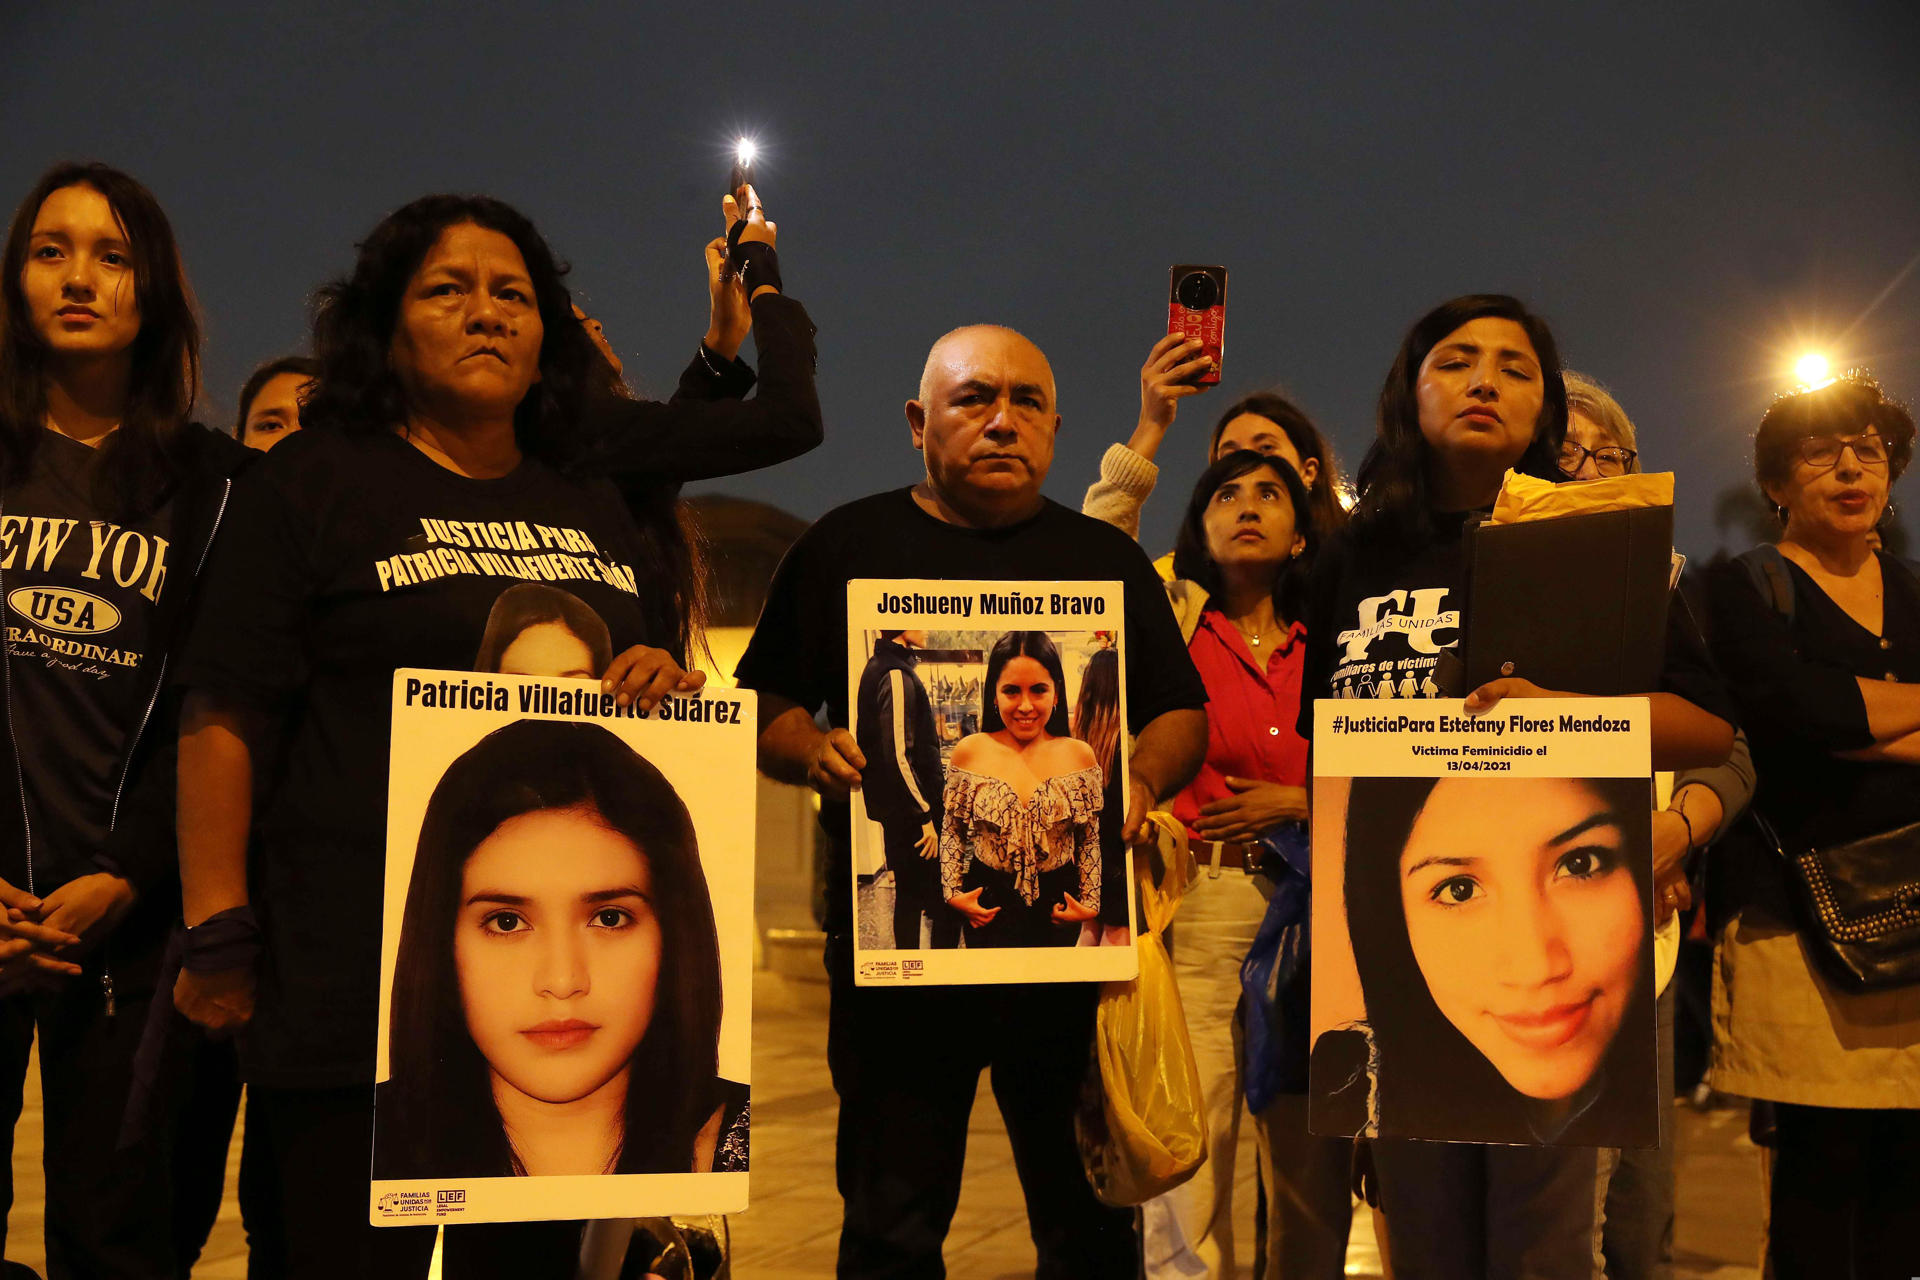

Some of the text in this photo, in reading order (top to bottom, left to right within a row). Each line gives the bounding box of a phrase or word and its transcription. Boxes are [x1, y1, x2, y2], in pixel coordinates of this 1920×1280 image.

[420, 517, 600, 557] JUSTICIA PARA
[375, 547, 481, 592] PATRICIA
[472, 551, 602, 583] VILLAFUERTE
[30, 591, 96, 631] USA
[877, 592, 1105, 618] Joshueny Muñoz Bravo
[1399, 613, 1453, 629] UNIDAS
[6, 626, 144, 668] RAORDINAR
[1378, 660, 1394, 671] de
[405, 678, 508, 712] Patricia
[659, 693, 741, 725] Suárez
[1333, 714, 1631, 736] #JusticiaPara Estefany Flores Mendoza
[1462, 745, 1533, 756] Feminicidio
[1536, 745, 1547, 756] el
[1447, 761, 1511, 772] 13/04/2021
[439, 1191, 464, 1201] LEF
